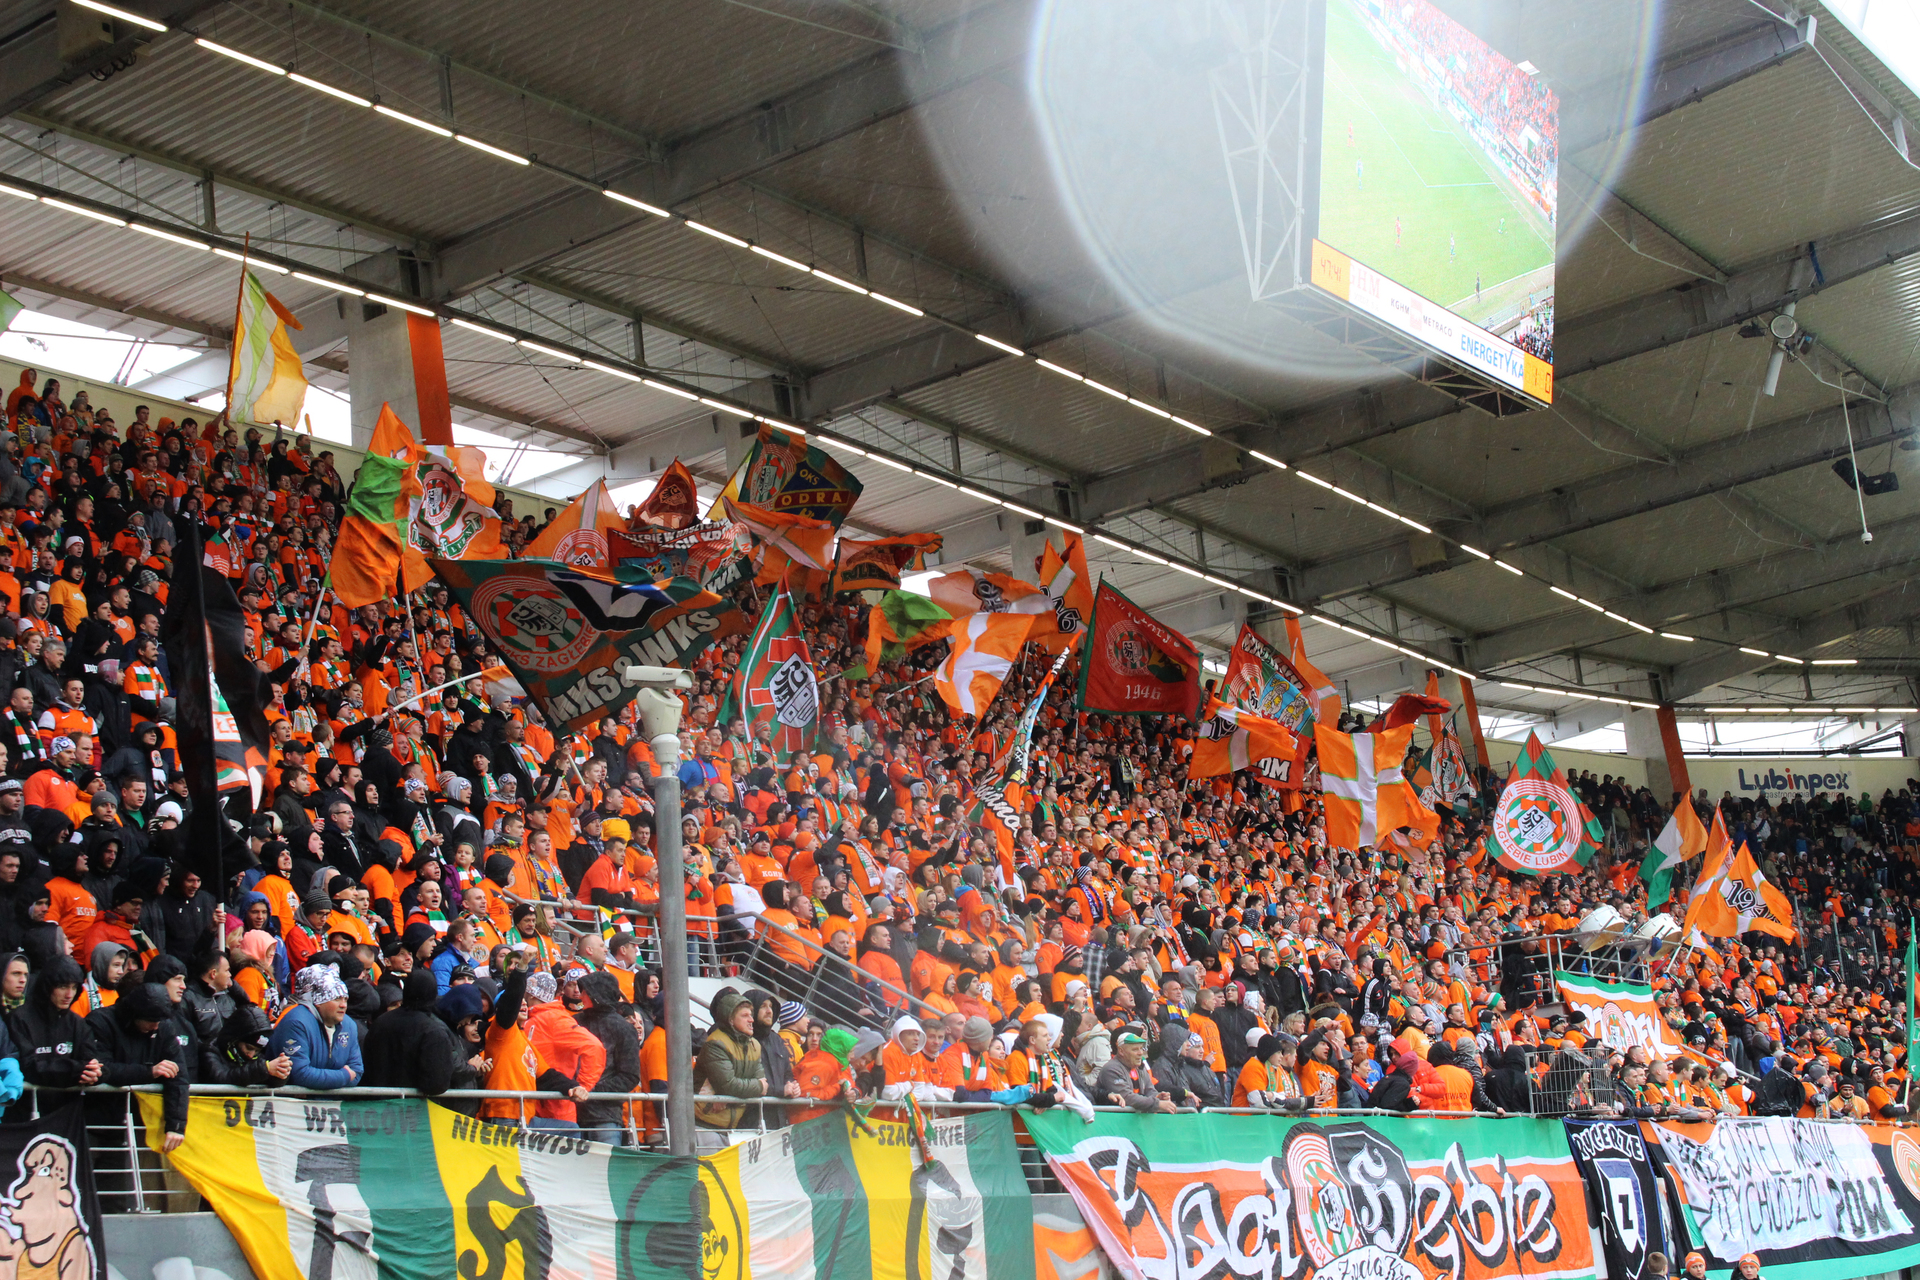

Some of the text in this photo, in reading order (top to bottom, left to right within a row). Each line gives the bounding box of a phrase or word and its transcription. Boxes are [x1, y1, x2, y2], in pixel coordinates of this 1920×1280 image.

[1389, 297, 1410, 315] KGHM
[1422, 314, 1453, 338] METRACO
[799, 468, 821, 486] OKS
[781, 491, 843, 506] ODRA
[1124, 683, 1162, 700] 1946
[1738, 767, 1850, 797] Lubinpex
[1497, 789, 1514, 811] MKS
[1535, 850, 1569, 866] LUBIN
[222, 1099, 277, 1128] DLA
[1572, 1122, 1645, 1162] RYCERZE
